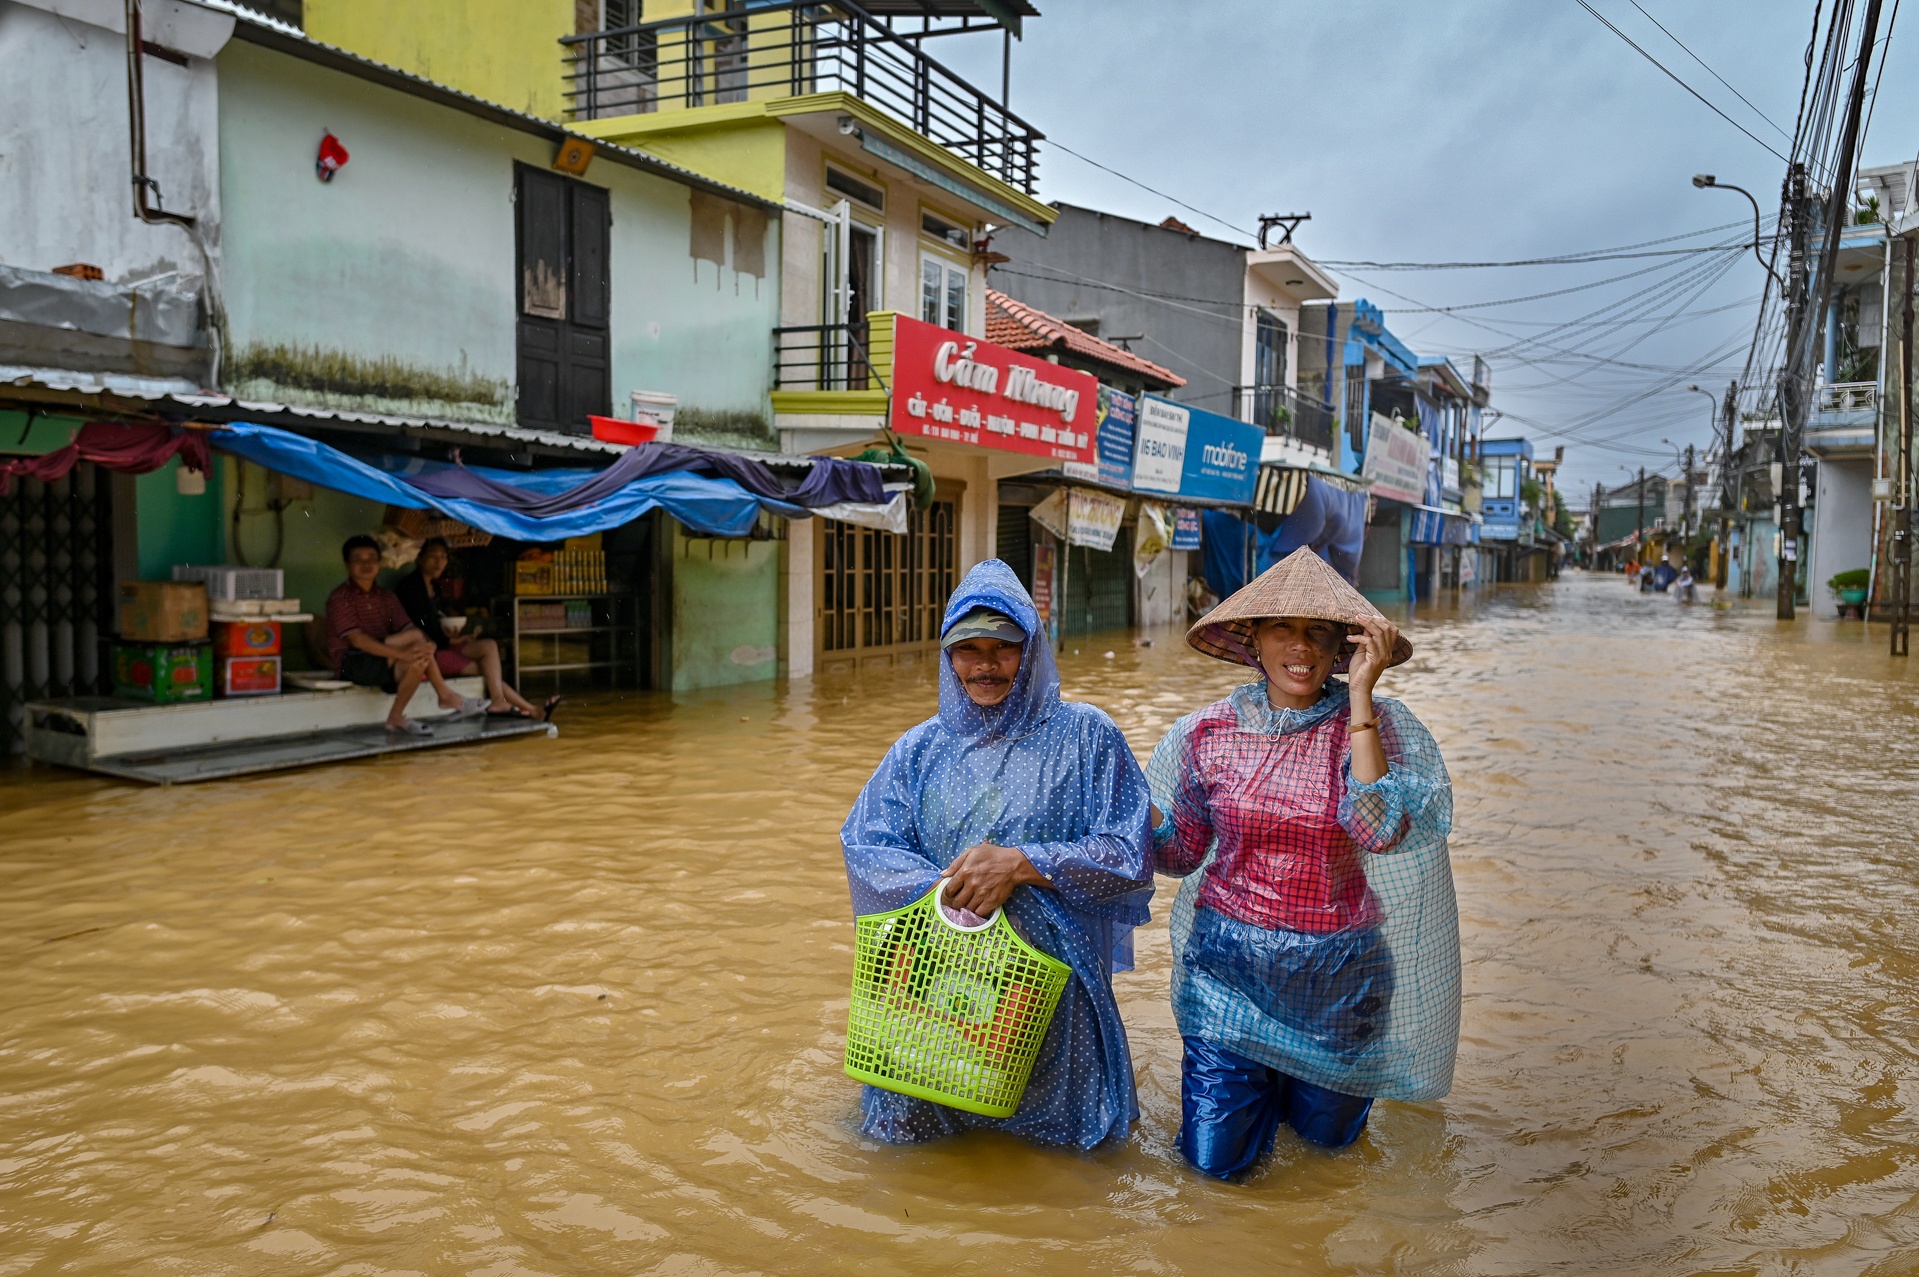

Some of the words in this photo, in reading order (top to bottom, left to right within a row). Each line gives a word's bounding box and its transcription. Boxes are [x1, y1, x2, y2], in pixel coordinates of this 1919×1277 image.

[934, 341, 999, 394] Cẩm
[1004, 364, 1080, 423] Nhung
[1202, 440, 1248, 471] mobifone
